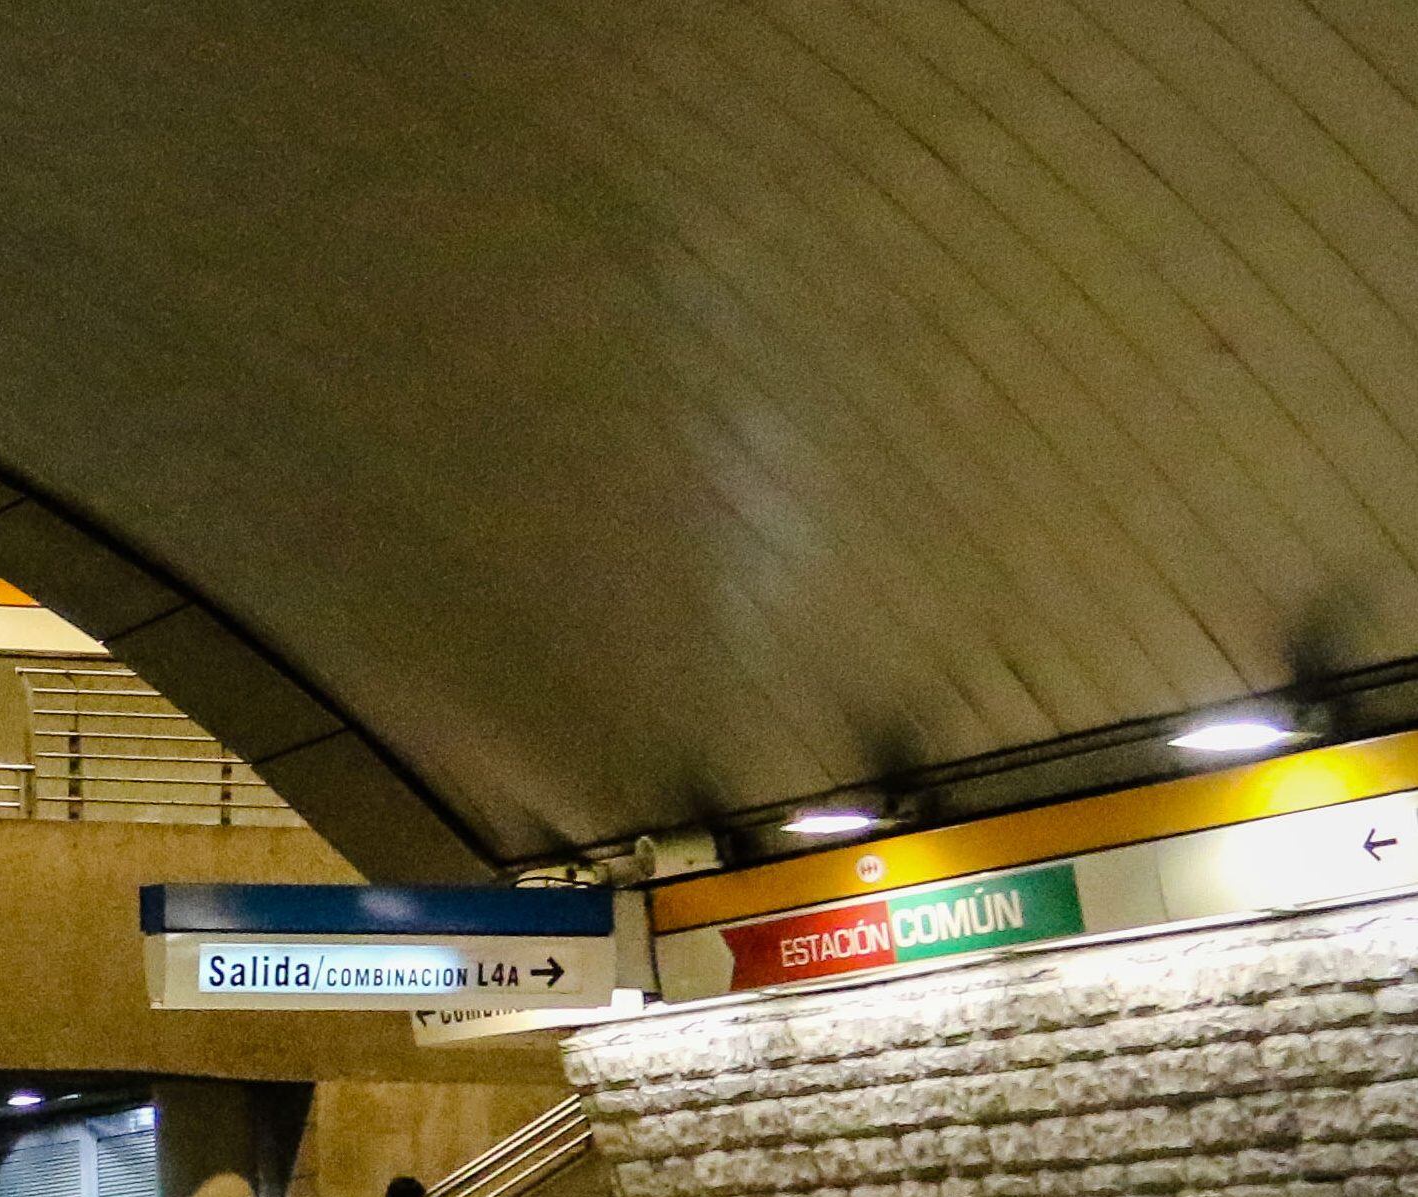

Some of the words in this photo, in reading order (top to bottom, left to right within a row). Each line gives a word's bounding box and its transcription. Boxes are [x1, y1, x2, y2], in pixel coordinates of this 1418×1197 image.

[780, 919, 891, 967] ESTACIÓN
[893, 887, 1023, 948] COMÚN
[476, 961, 519, 987] L4A
